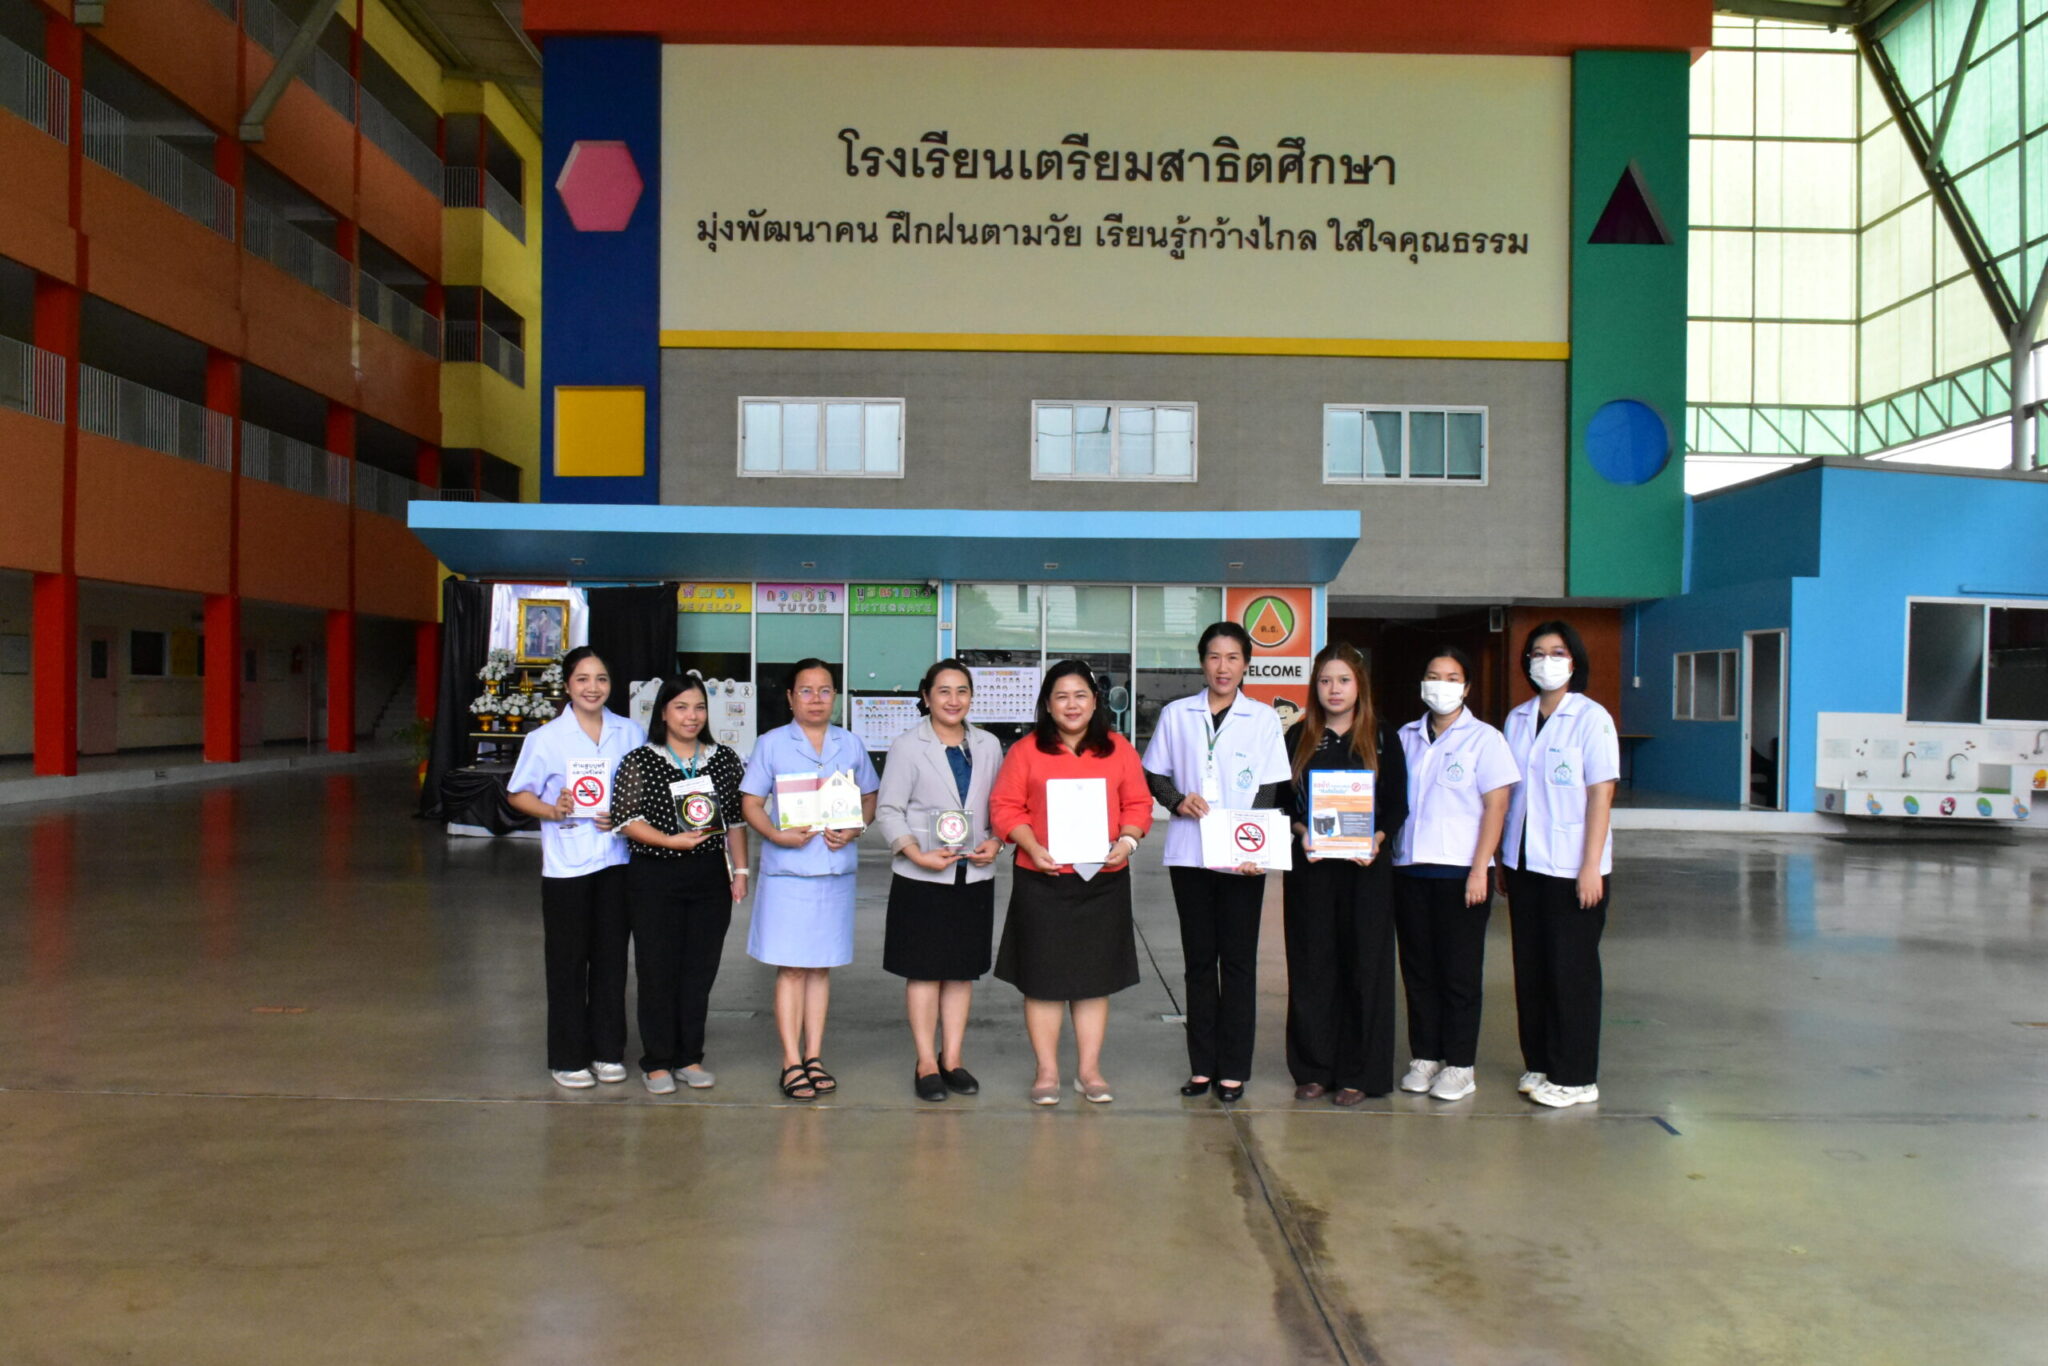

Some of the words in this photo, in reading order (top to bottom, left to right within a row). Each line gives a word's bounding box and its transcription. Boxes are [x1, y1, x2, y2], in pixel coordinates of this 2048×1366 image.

[837, 127, 1396, 186] โรงเรียนเตรียมสาธิตศึกษา
[697, 208, 879, 253] มุ่งพัฒนาคน
[885, 210, 1081, 247] ฝึกฝนตามวัย
[1096, 212, 1317, 260] เรียนรู้กว้างไกล
[1326, 216, 1528, 265] ใส่ใจคุณธรรม
[766, 586, 836, 602] กวดวิชา
[778, 602, 828, 613] TUTOR
[1243, 665, 1302, 677] ELCOME
